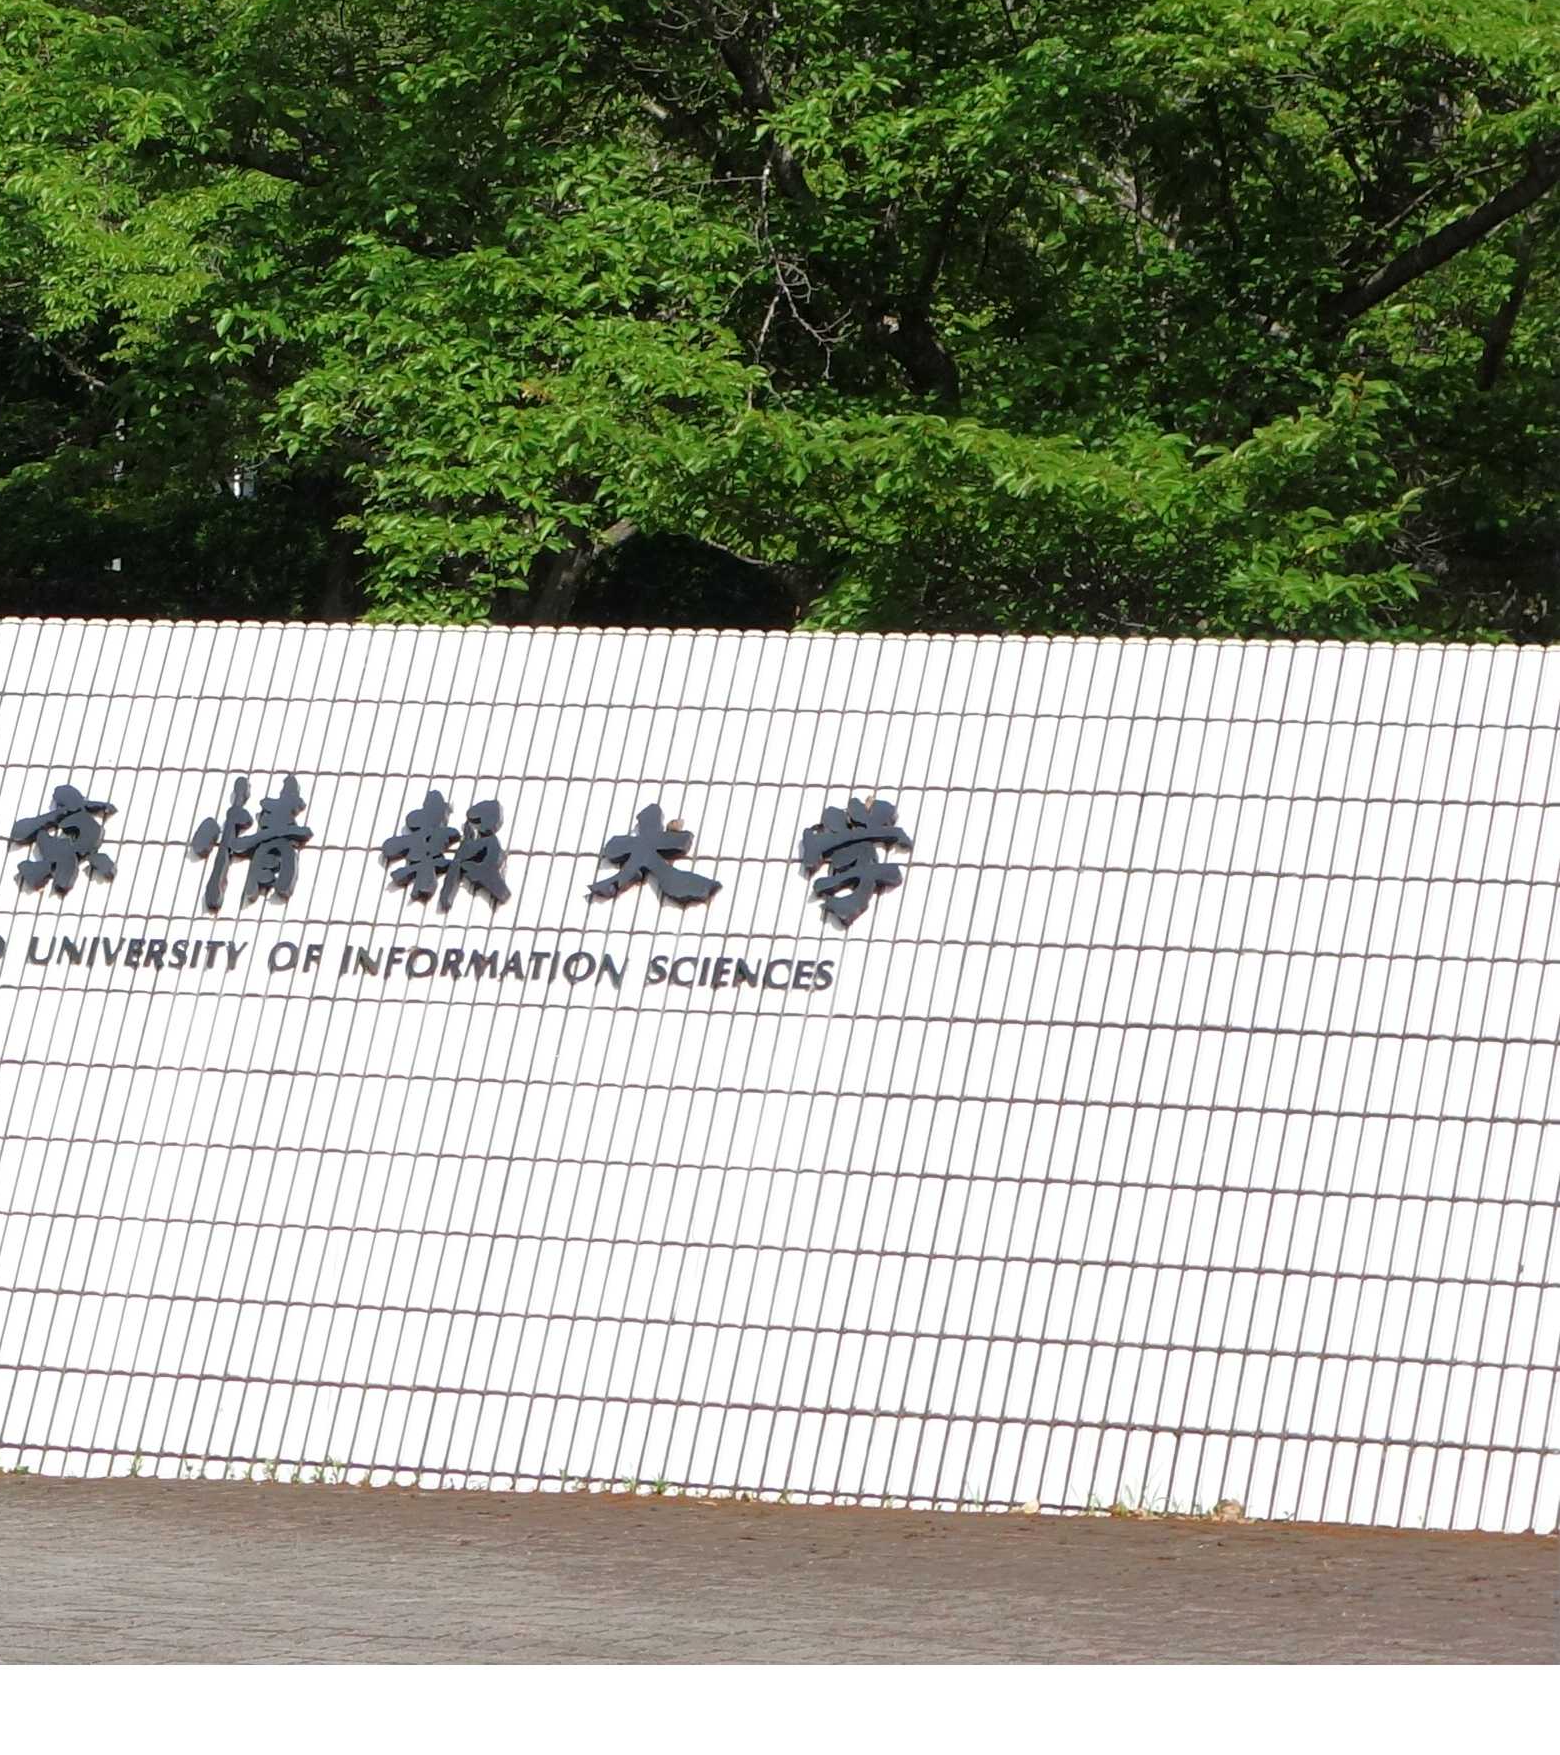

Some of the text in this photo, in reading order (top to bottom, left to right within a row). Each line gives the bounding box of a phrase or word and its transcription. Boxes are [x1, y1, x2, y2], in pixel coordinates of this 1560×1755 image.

[27, 936, 248, 972] UNIVERSITY
[268, 941, 324, 974] OF
[340, 945, 628, 989] INFORMATION
[648, 954, 836, 992] SCIENCES
